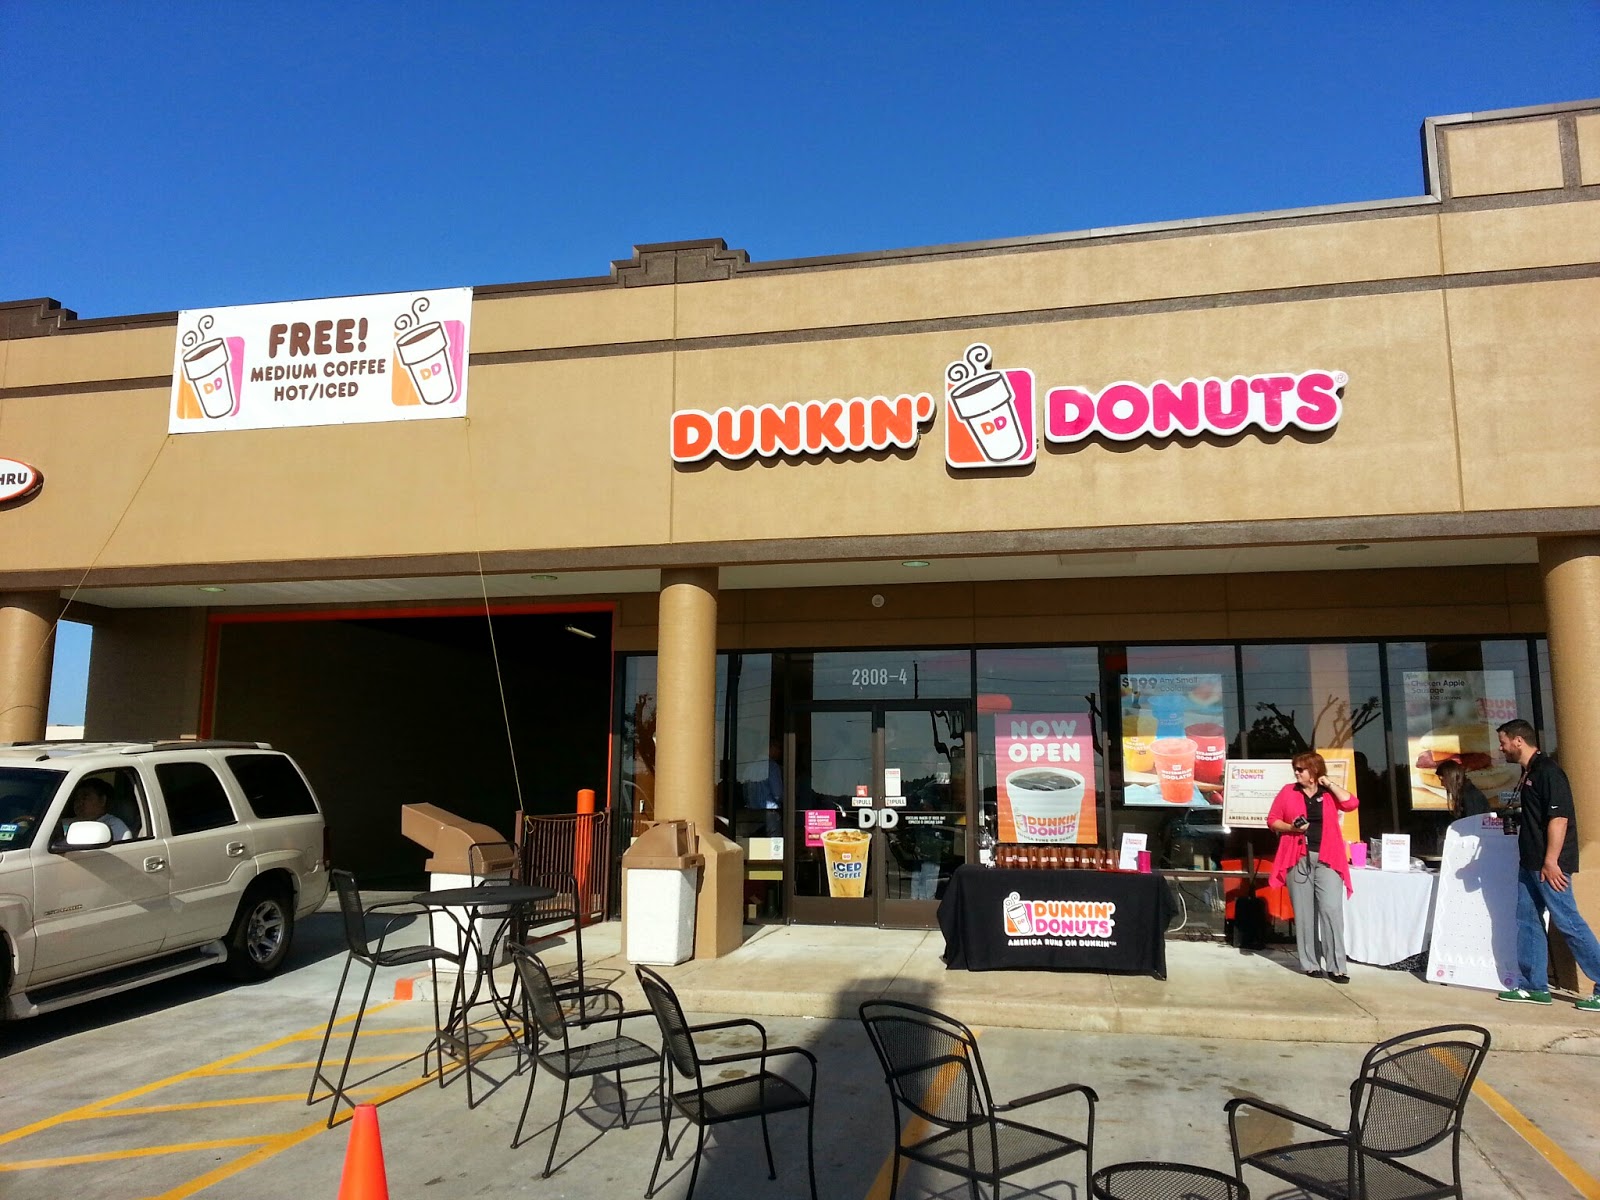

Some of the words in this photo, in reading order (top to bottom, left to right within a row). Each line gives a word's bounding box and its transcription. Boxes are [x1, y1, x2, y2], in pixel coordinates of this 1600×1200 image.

[269, 317, 368, 358] FREE!
[251, 363, 317, 382] MEDIUM
[323, 358, 386, 378] COFFEE
[420, 363, 442, 380] DD
[203, 377, 222, 394] DD
[274, 382, 359, 402] HOT/ICED
[673, 396, 930, 458] DUNKIN'
[1050, 373, 1338, 436] DONUTS
[981, 416, 1007, 435] DD
[852, 668, 907, 686] 2808-4
[1176, 676, 1198, 684] Small
[1443, 679, 1465, 688] Apple
[1011, 720, 1077, 740] NOW
[1008, 742, 1080, 763] OPEN
[832, 861, 862, 872] ICED
[833, 871, 862, 879] COFFEE
[1034, 903, 1113, 919] DUNKIN'
[1035, 919, 1109, 934] DONUTS
[1044, 939, 1063, 947] RUNS
[1065, 939, 1078, 947] ON
